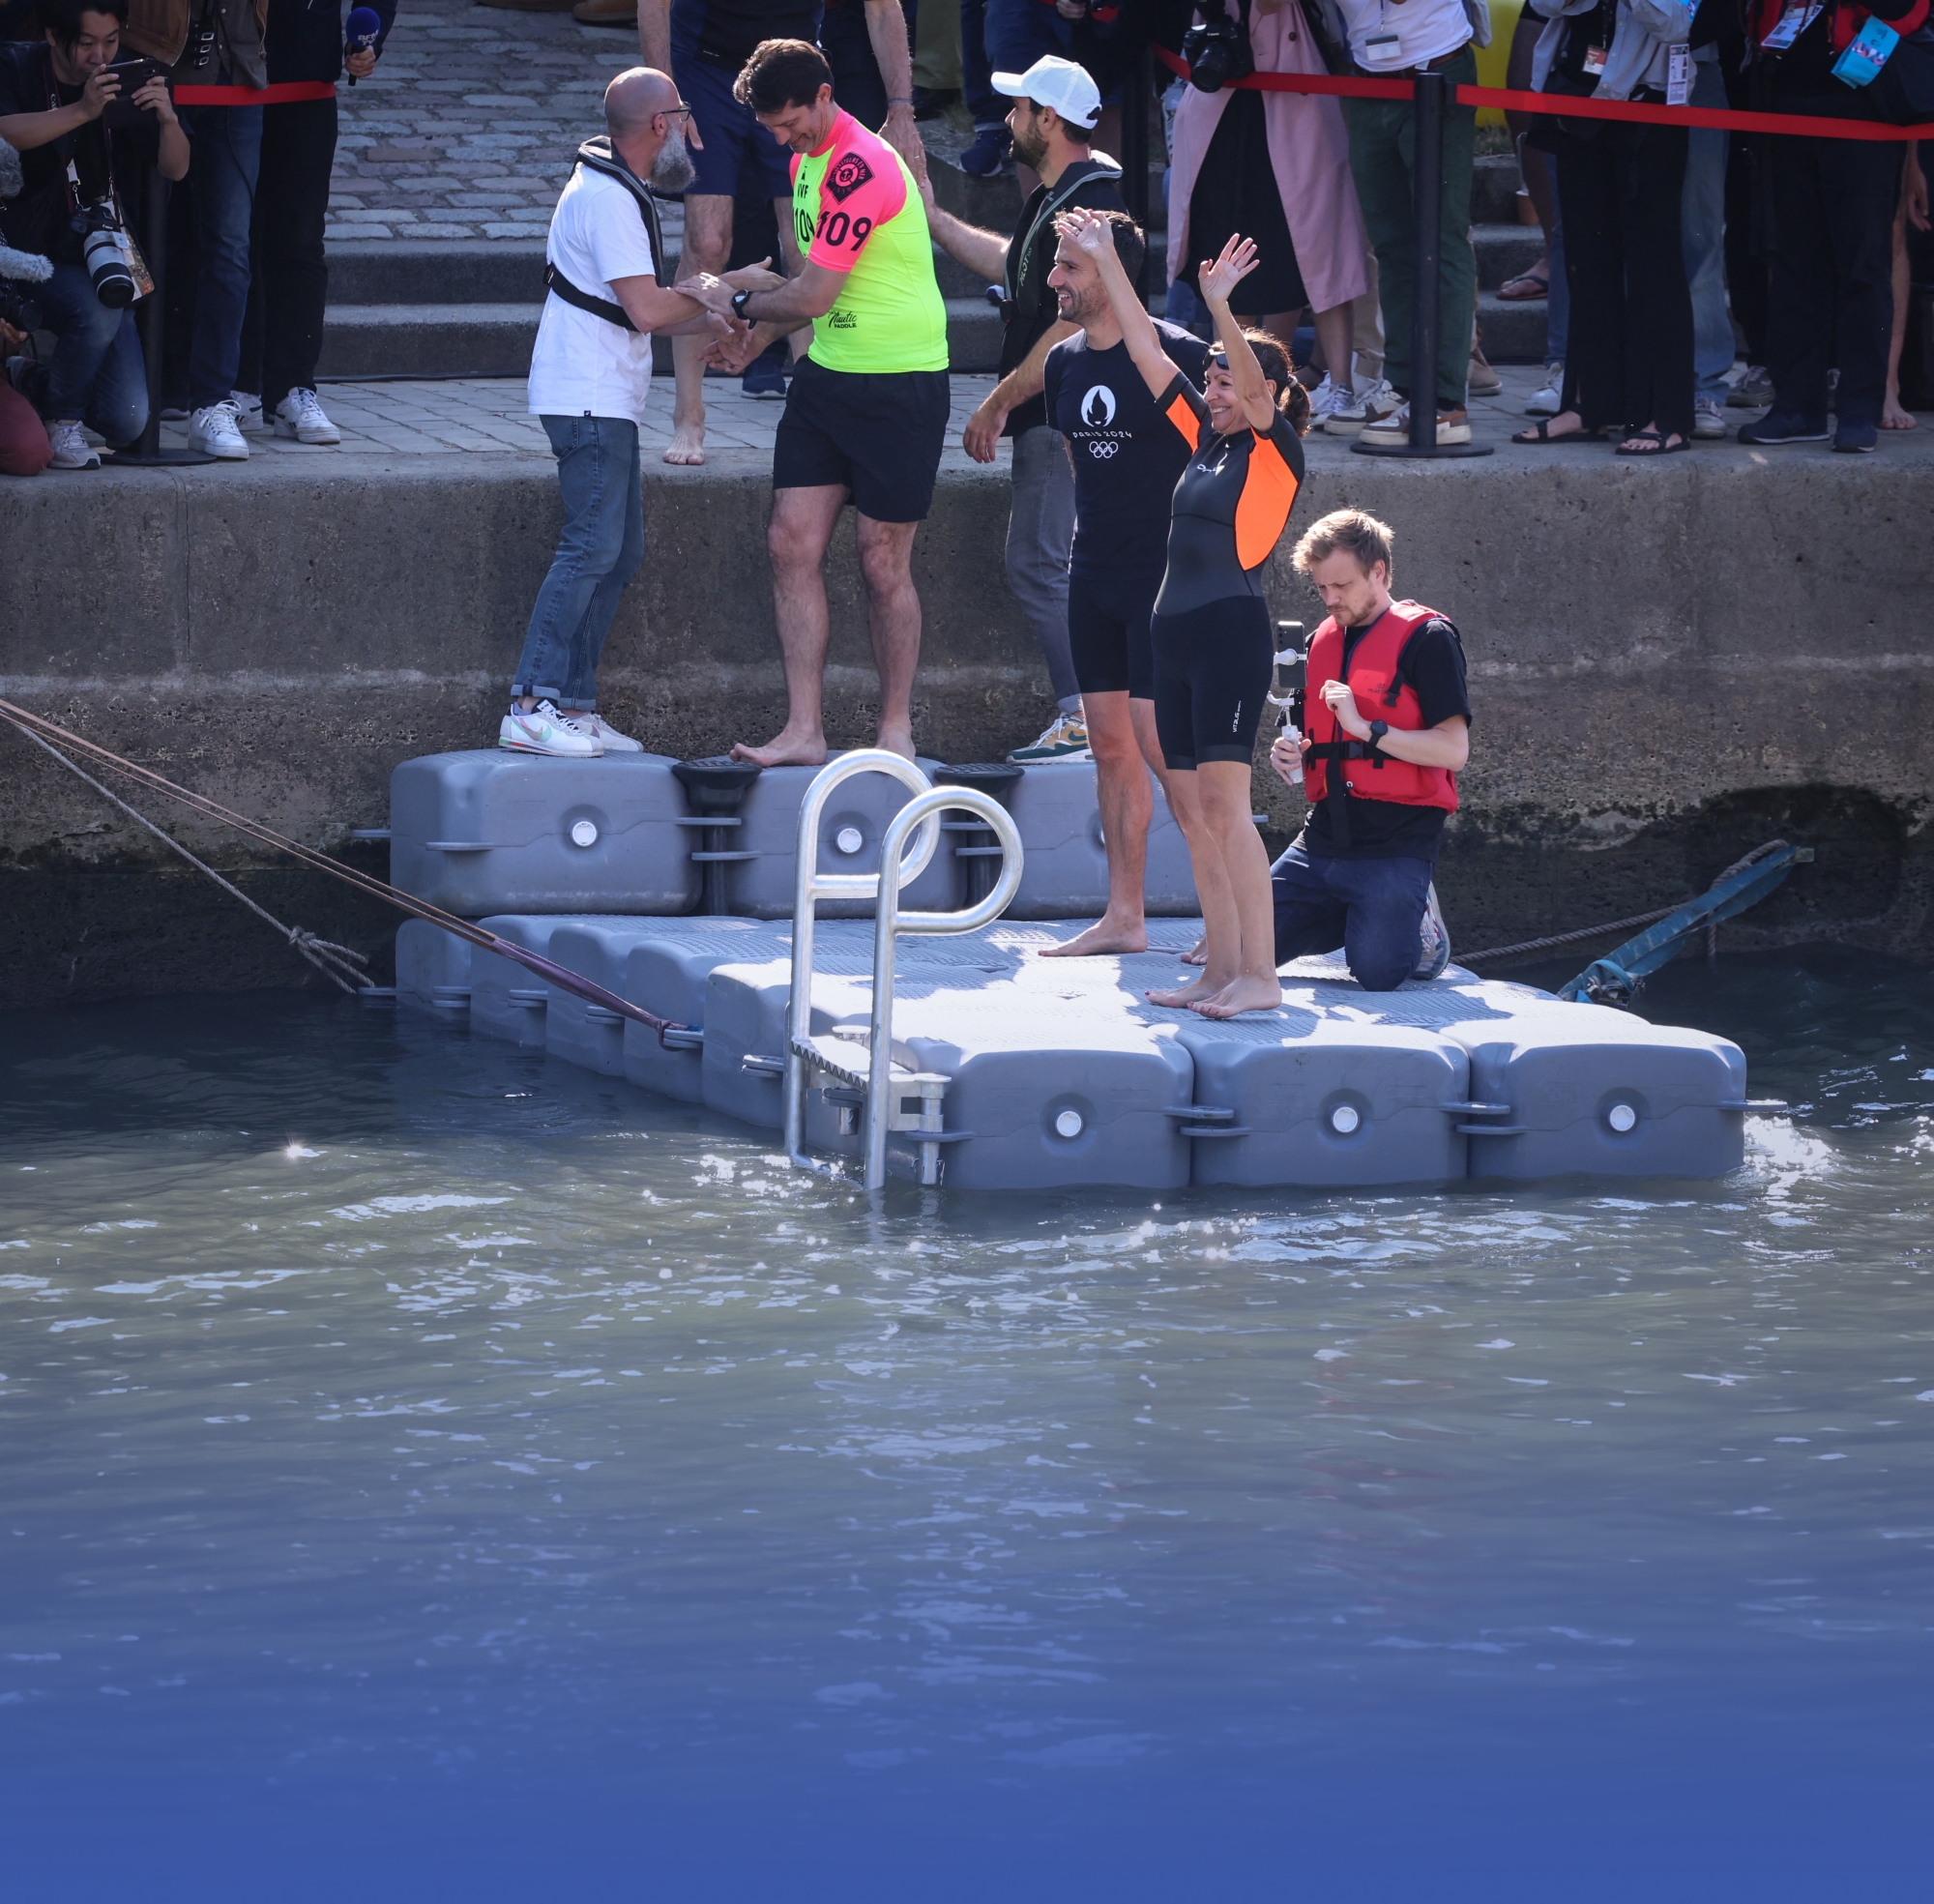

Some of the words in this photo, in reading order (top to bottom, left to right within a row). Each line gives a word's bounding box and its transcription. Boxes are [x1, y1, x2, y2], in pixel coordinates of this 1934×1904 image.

[357, 29, 379, 42] BFM
[362, 38, 376, 46] TV
[816, 211, 872, 251] 109
[828, 310, 858, 328] Nautic
